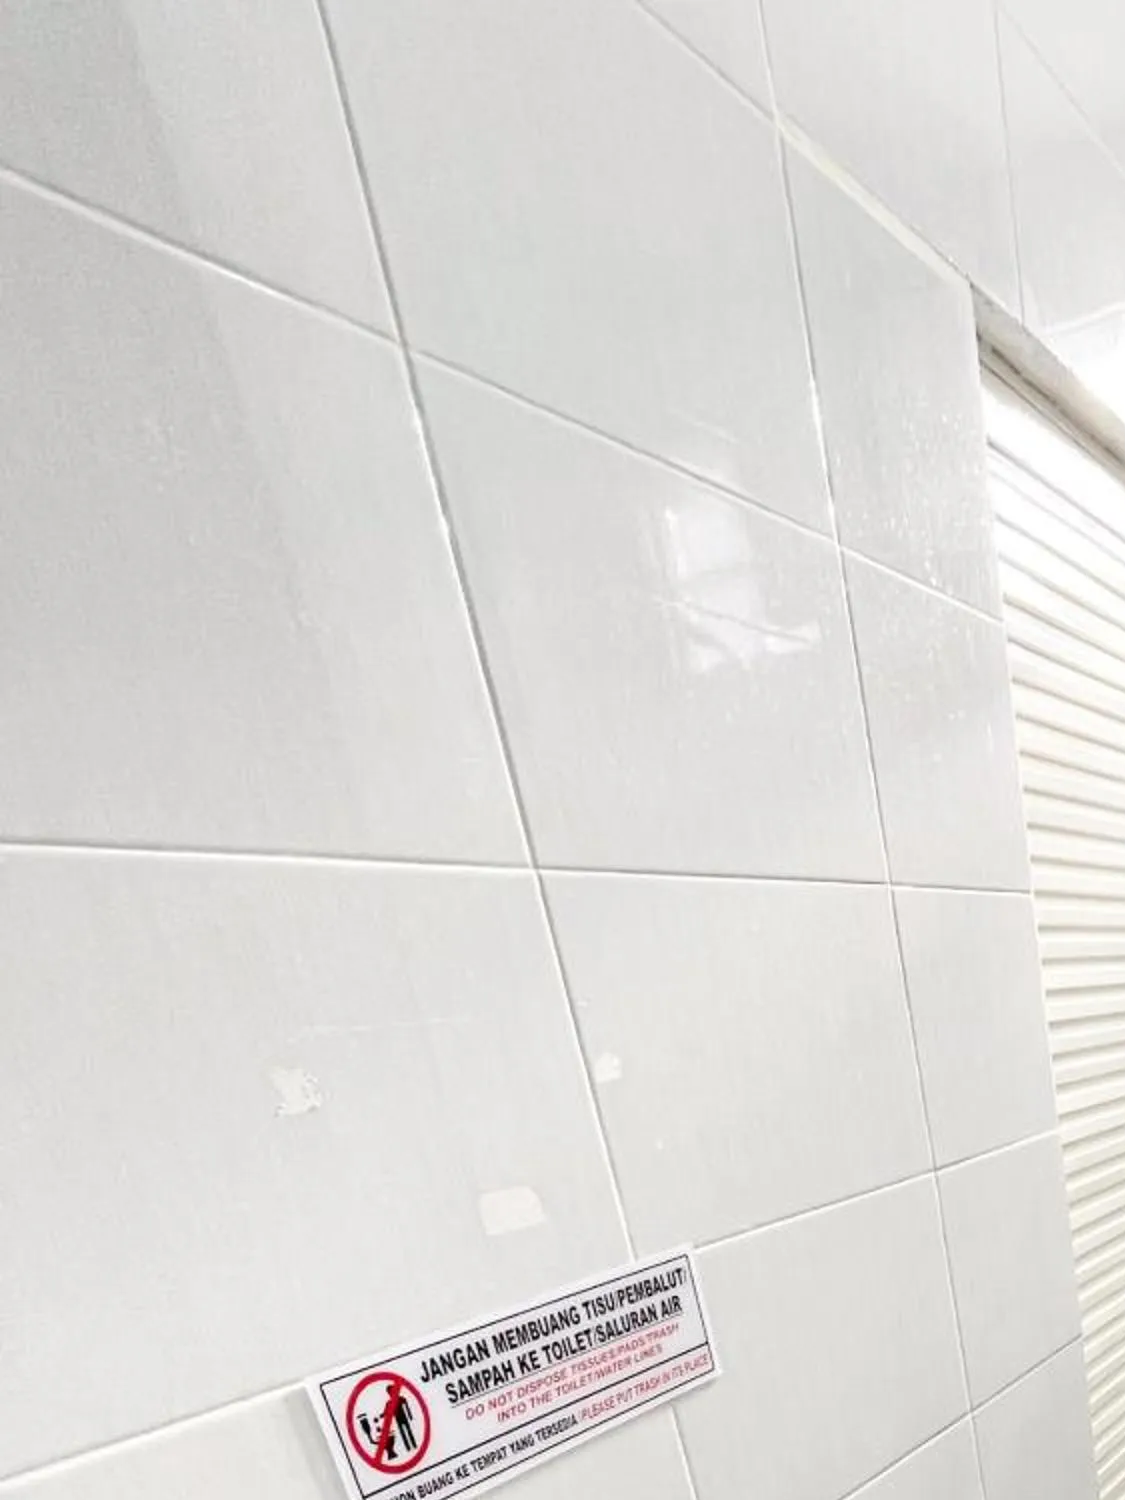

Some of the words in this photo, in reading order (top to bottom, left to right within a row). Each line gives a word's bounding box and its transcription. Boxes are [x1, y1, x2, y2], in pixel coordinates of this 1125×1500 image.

[420, 1339, 491, 1383] JANGAN
[491, 1306, 581, 1355] MEMBUANG
[445, 1359, 516, 1404] SAMPAH
[516, 1350, 541, 1375] KE
[541, 1303, 659, 1364] TOILET/SALURAN
[660, 1295, 683, 1318] AIR
[497, 1403, 527, 1423] INTO
[530, 1392, 553, 1409] THE
[633, 1343, 664, 1363] LINES
[417, 1471, 454, 1499] BUANG
[455, 1462, 471, 1480] KE
[470, 1446, 509, 1473] TEMPAT
[509, 1433, 535, 1454] YANG
[535, 1414, 579, 1442] TERSEDIA
[616, 1387, 634, 1405] PUT
[634, 1377, 661, 1395] TRASH
[684, 1353, 710, 1375] PLACE
[465, 1403, 485, 1421] DO
[487, 1391, 516, 1411] NOT
[516, 1367, 568, 1399] DISPOSE
